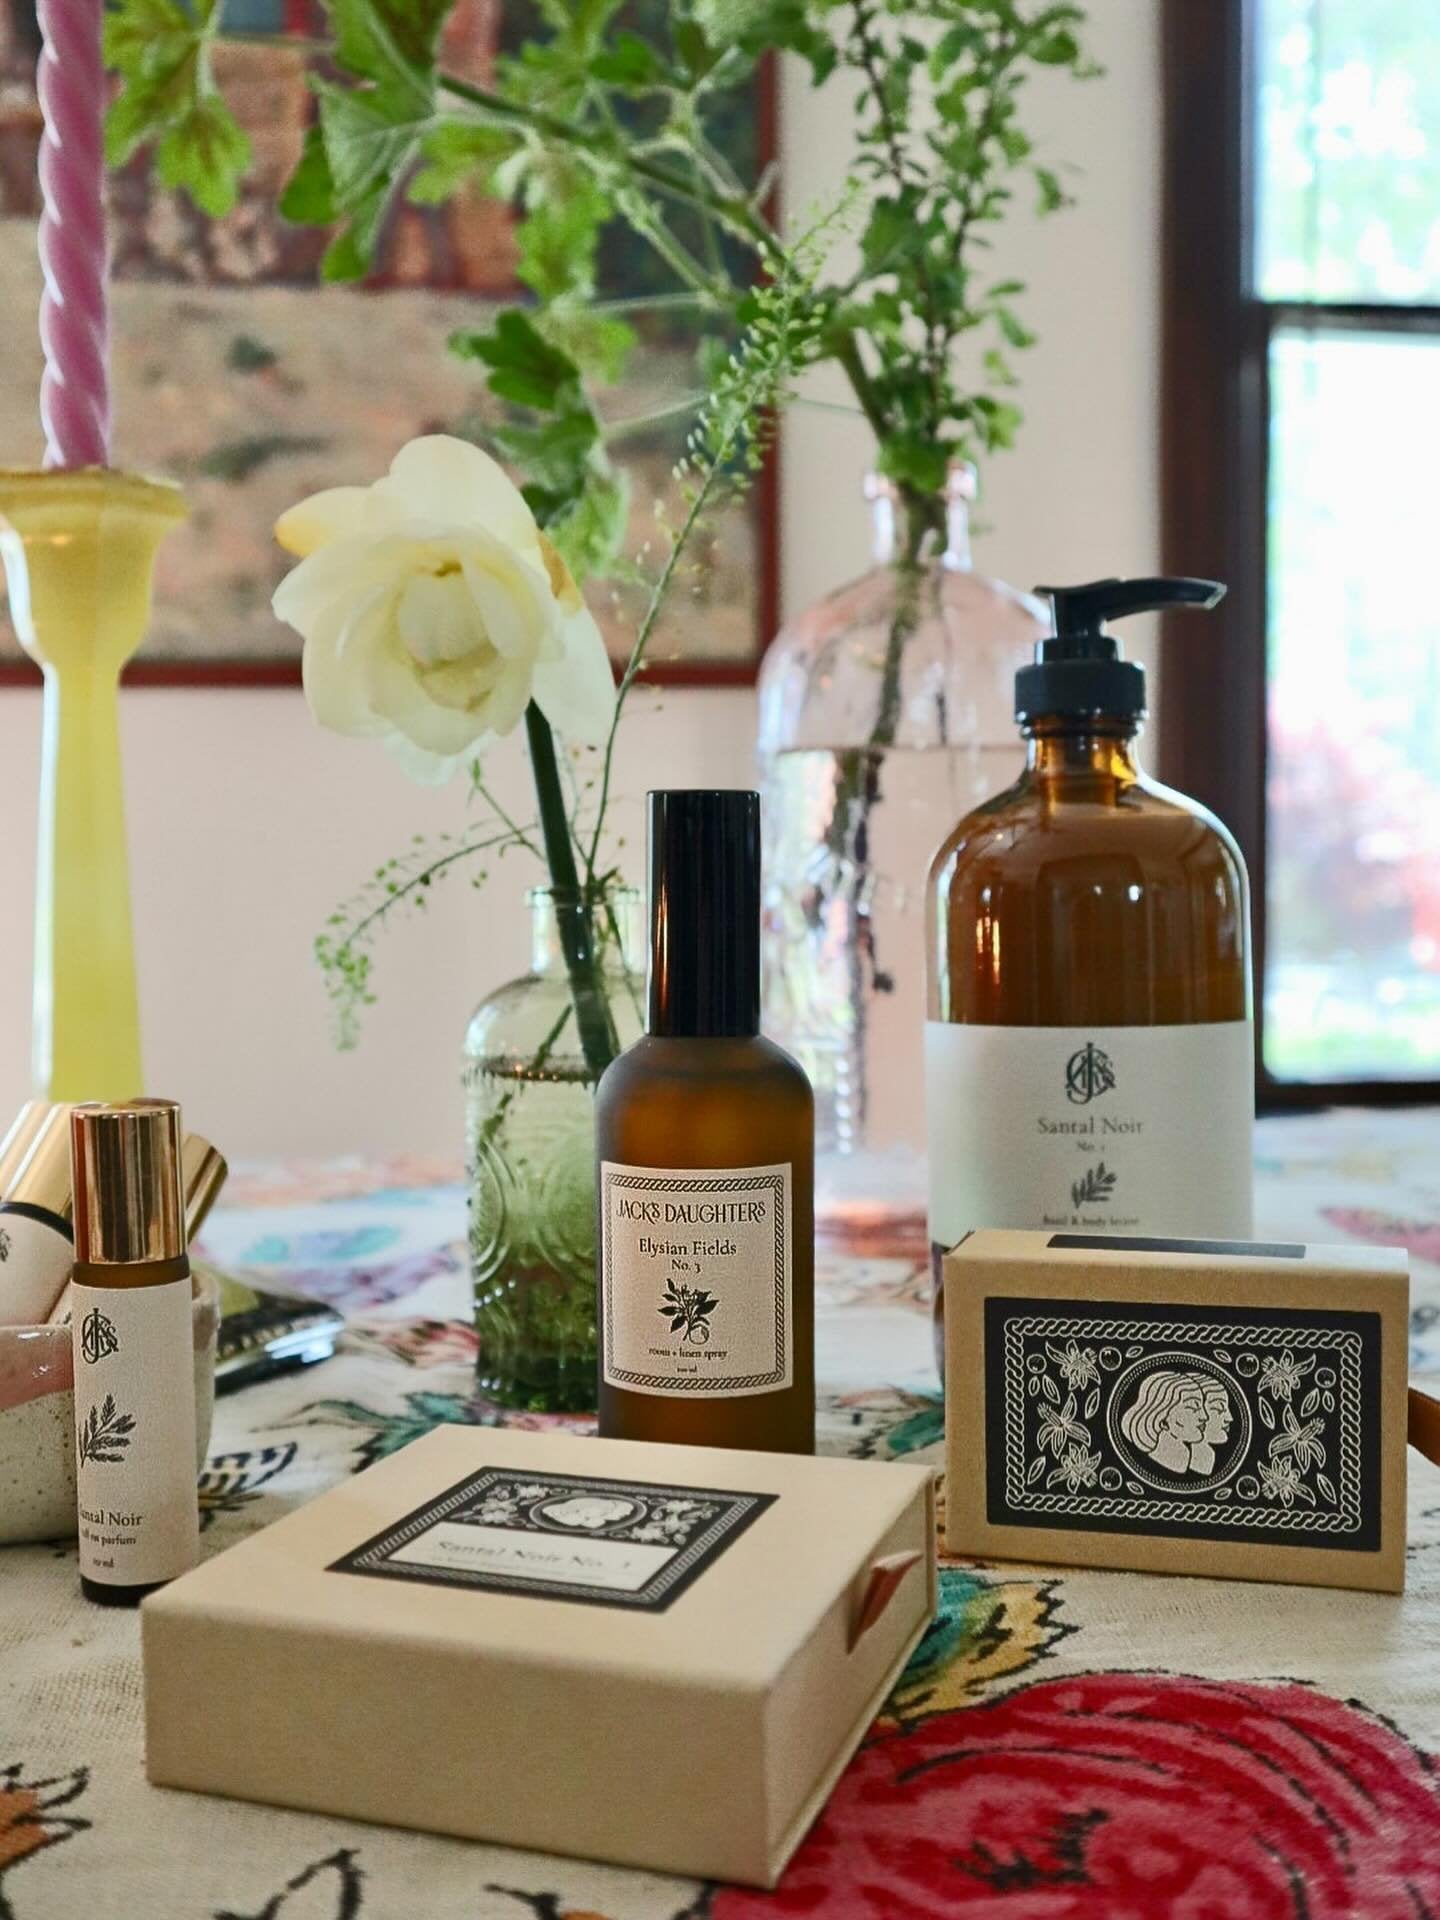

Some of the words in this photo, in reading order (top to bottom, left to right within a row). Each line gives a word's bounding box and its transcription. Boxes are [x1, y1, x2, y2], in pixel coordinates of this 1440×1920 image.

[1037, 1114, 1095, 1135] Santal
[1101, 1115, 1144, 1135] Noir
[664, 1201, 767, 1224] DAUGHTERS
[639, 1237, 688, 1258] Elysian
[692, 1239, 737, 1256] Fields
[671, 1259, 691, 1272] No.
[694, 1262, 702, 1274] 3
[679, 1346, 702, 1358] linen
[703, 1350, 728, 1361] spray
[108, 1511, 143, 1527] Noir
[101, 1533, 137, 1548] parfum
